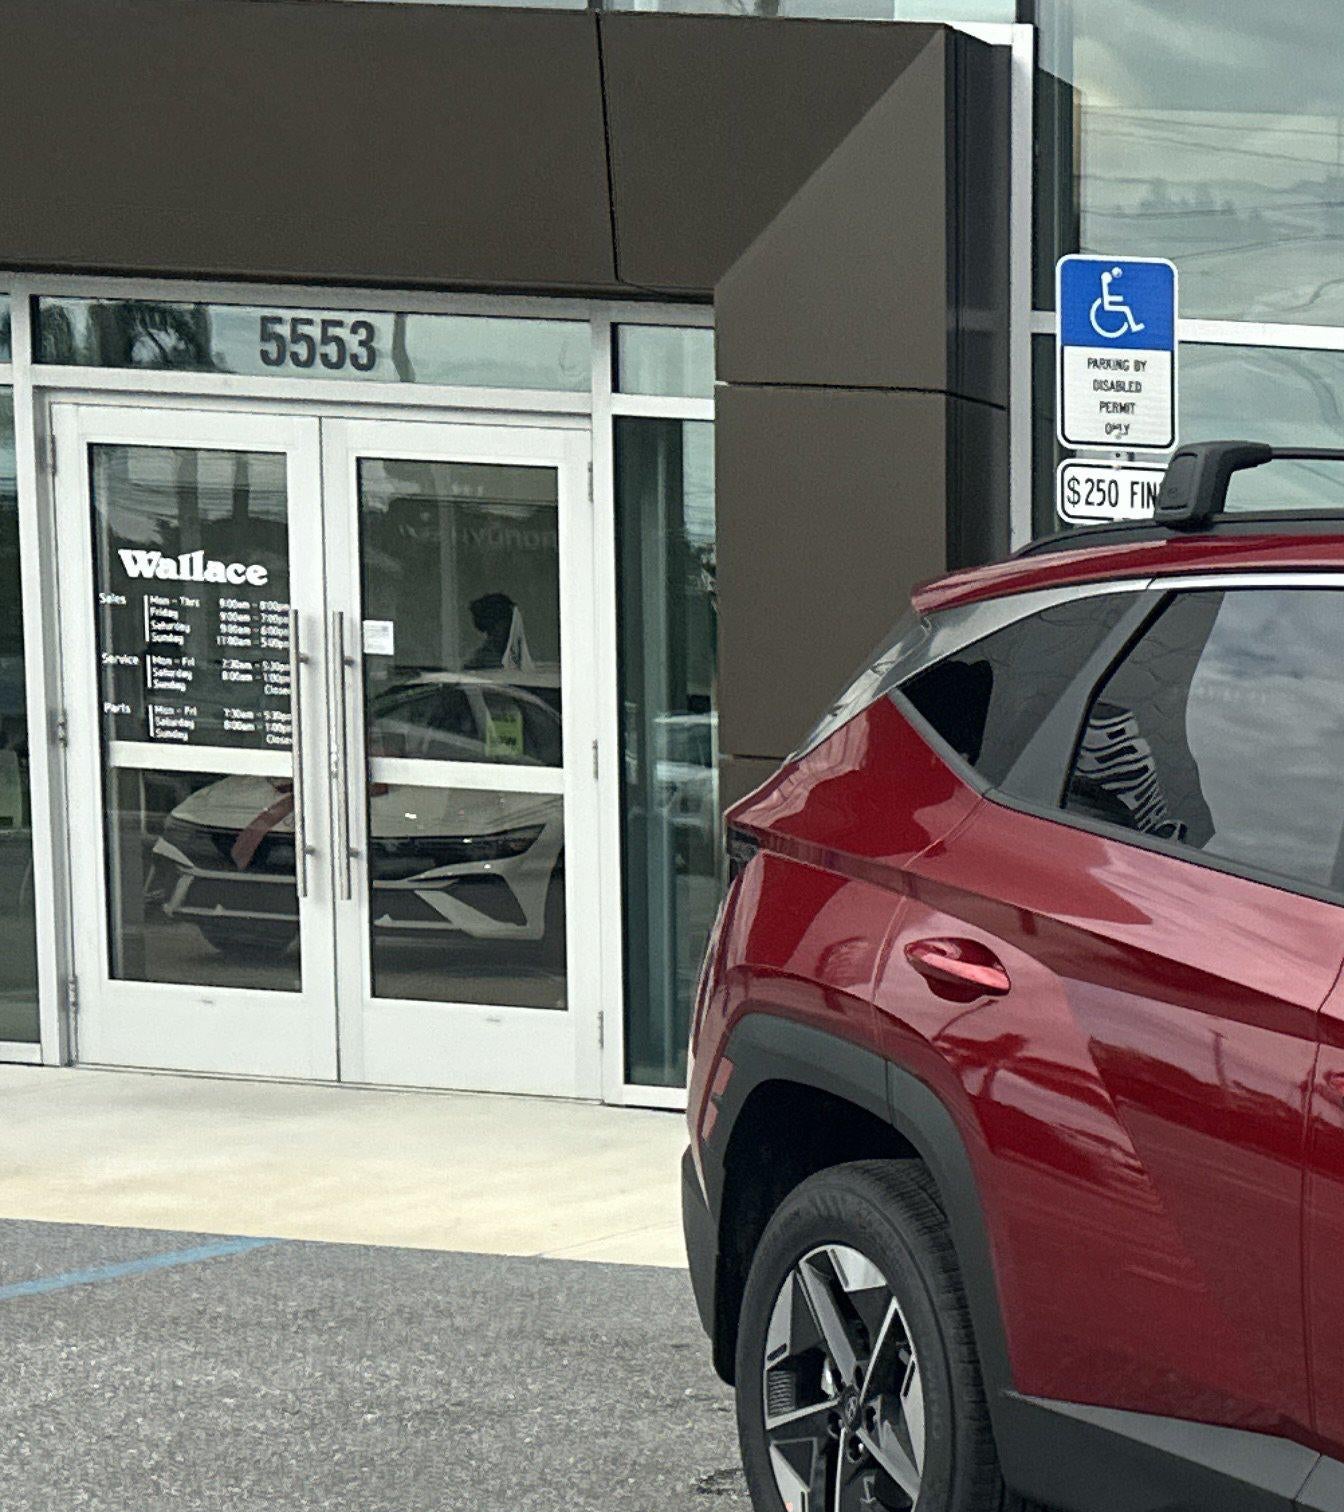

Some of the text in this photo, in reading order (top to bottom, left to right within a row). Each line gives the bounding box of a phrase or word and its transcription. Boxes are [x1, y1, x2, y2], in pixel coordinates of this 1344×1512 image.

[259, 315, 376, 371] 5553
[1087, 357, 1147, 372] PARKING BY
[1092, 379, 1142, 393] DISABLED
[1099, 401, 1136, 415] PERMIT
[1066, 475, 1157, 509] $250 FIN
[118, 549, 268, 586] Wallace
[99, 593, 126, 605] Sales
[102, 652, 139, 665] Service
[104, 702, 131, 713] Parts
